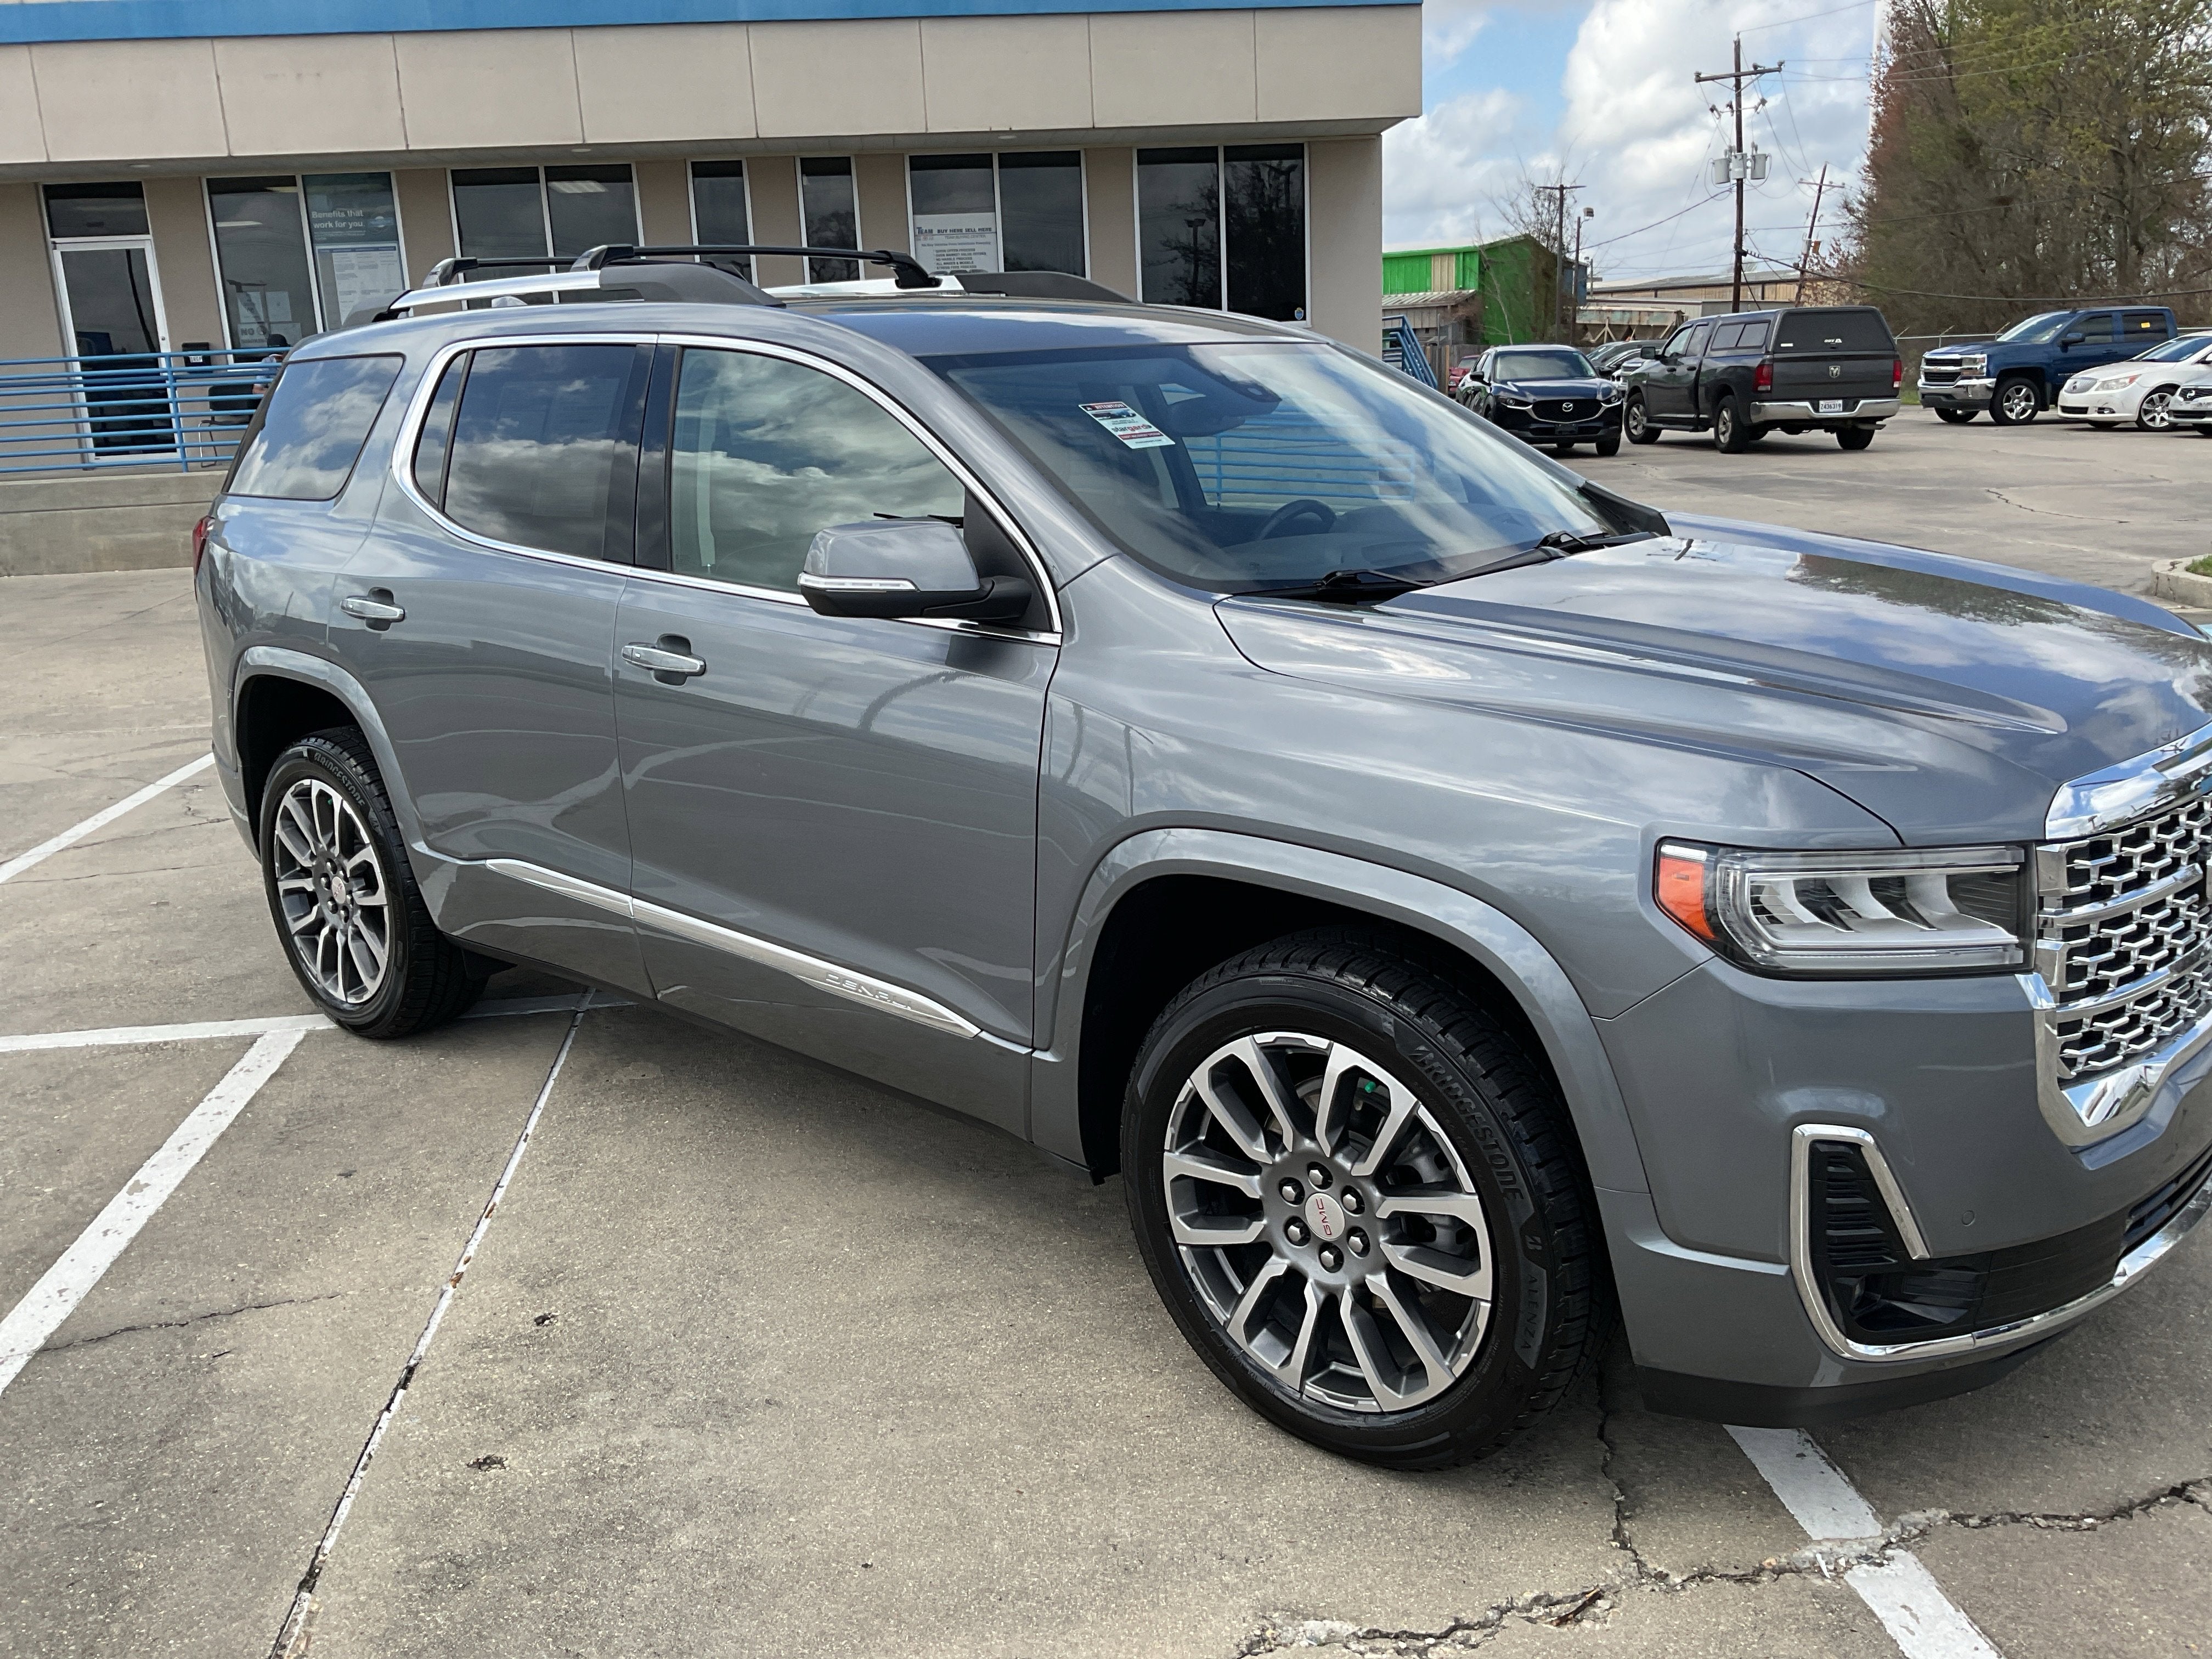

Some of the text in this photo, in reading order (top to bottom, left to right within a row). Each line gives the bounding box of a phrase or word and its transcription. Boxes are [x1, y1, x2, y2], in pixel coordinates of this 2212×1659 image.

[311, 210, 346, 218] Benefits
[313, 752, 366, 806] BRIDGESTONE
[1408, 1045, 1525, 1201] BRIDGESTONE
[1315, 1197, 1333, 1236] GMC
[1521, 1274, 1539, 1349] ALENZA
